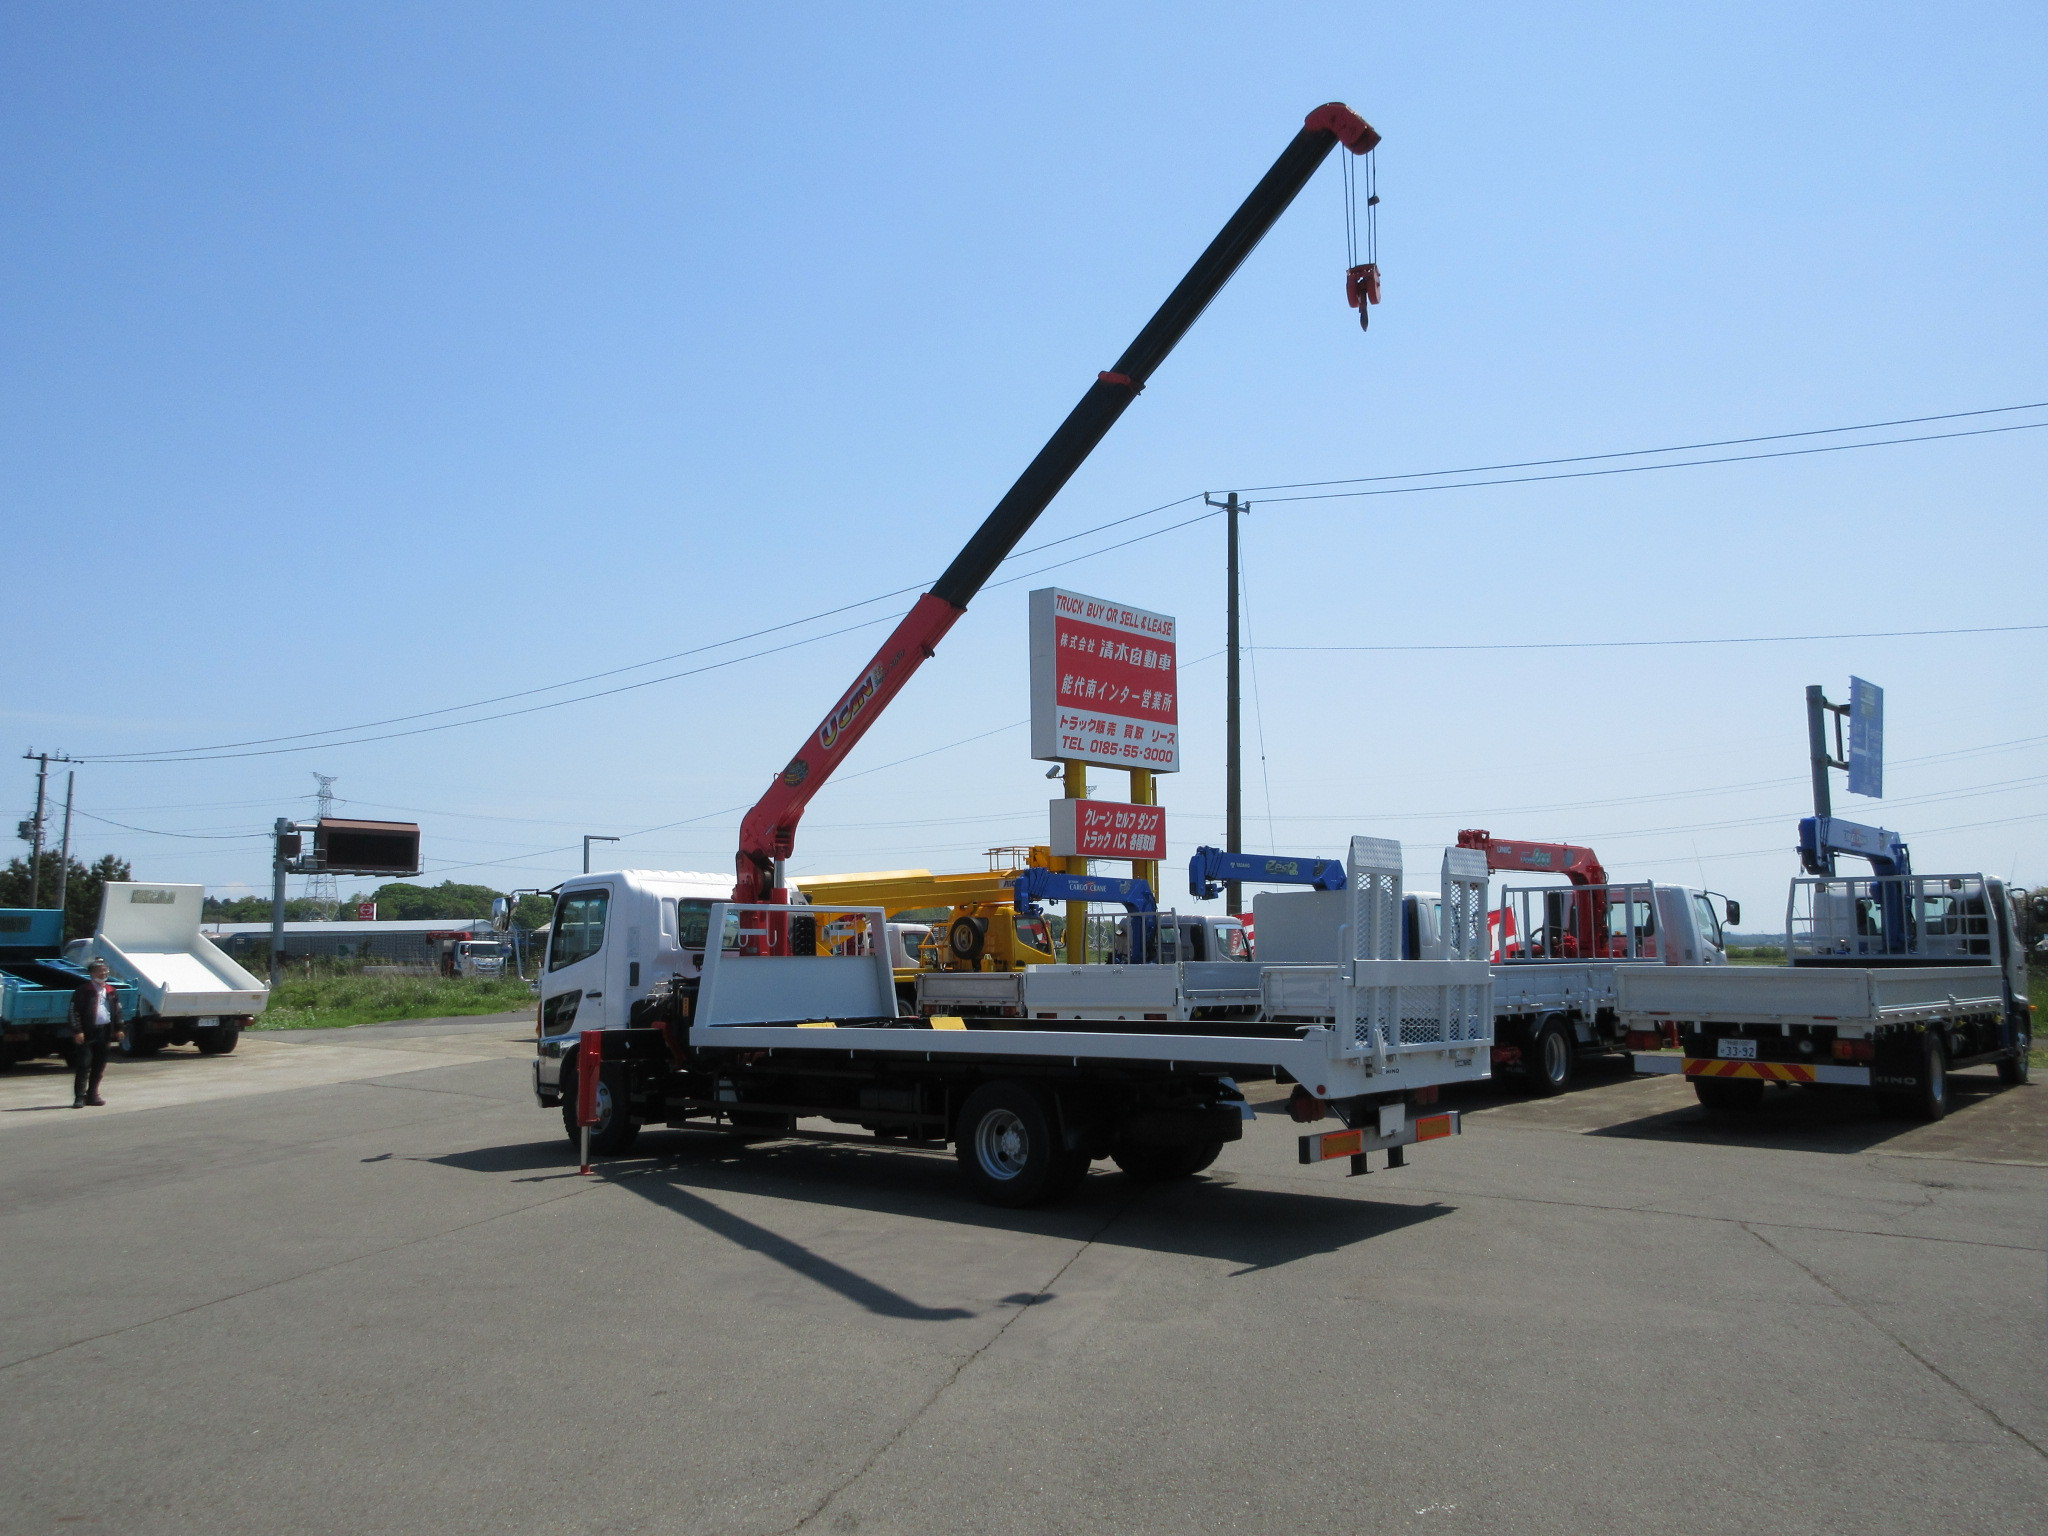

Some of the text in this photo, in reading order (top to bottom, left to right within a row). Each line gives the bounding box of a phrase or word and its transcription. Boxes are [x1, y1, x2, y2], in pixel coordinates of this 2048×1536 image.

[1056, 595, 1083, 615] TRUCK
[1086, 602, 1105, 619] BUY
[1106, 608, 1118, 623] OR
[1119, 611, 1138, 628] SELL
[1147, 618, 1172, 636] LEASE
[1060, 632, 1172, 671] 株式会社 清水自動車
[1061, 673, 1173, 713] 能代南インター営業所
[1062, 735, 1085, 751] TEL
[1151, 729, 1176, 746] リース
[1084, 808, 1113, 828] クレーン
[1115, 811, 1137, 829] セルフ
[1083, 829, 1112, 849] トラック
[1069, 883, 1107, 892] CARGO CRANE
